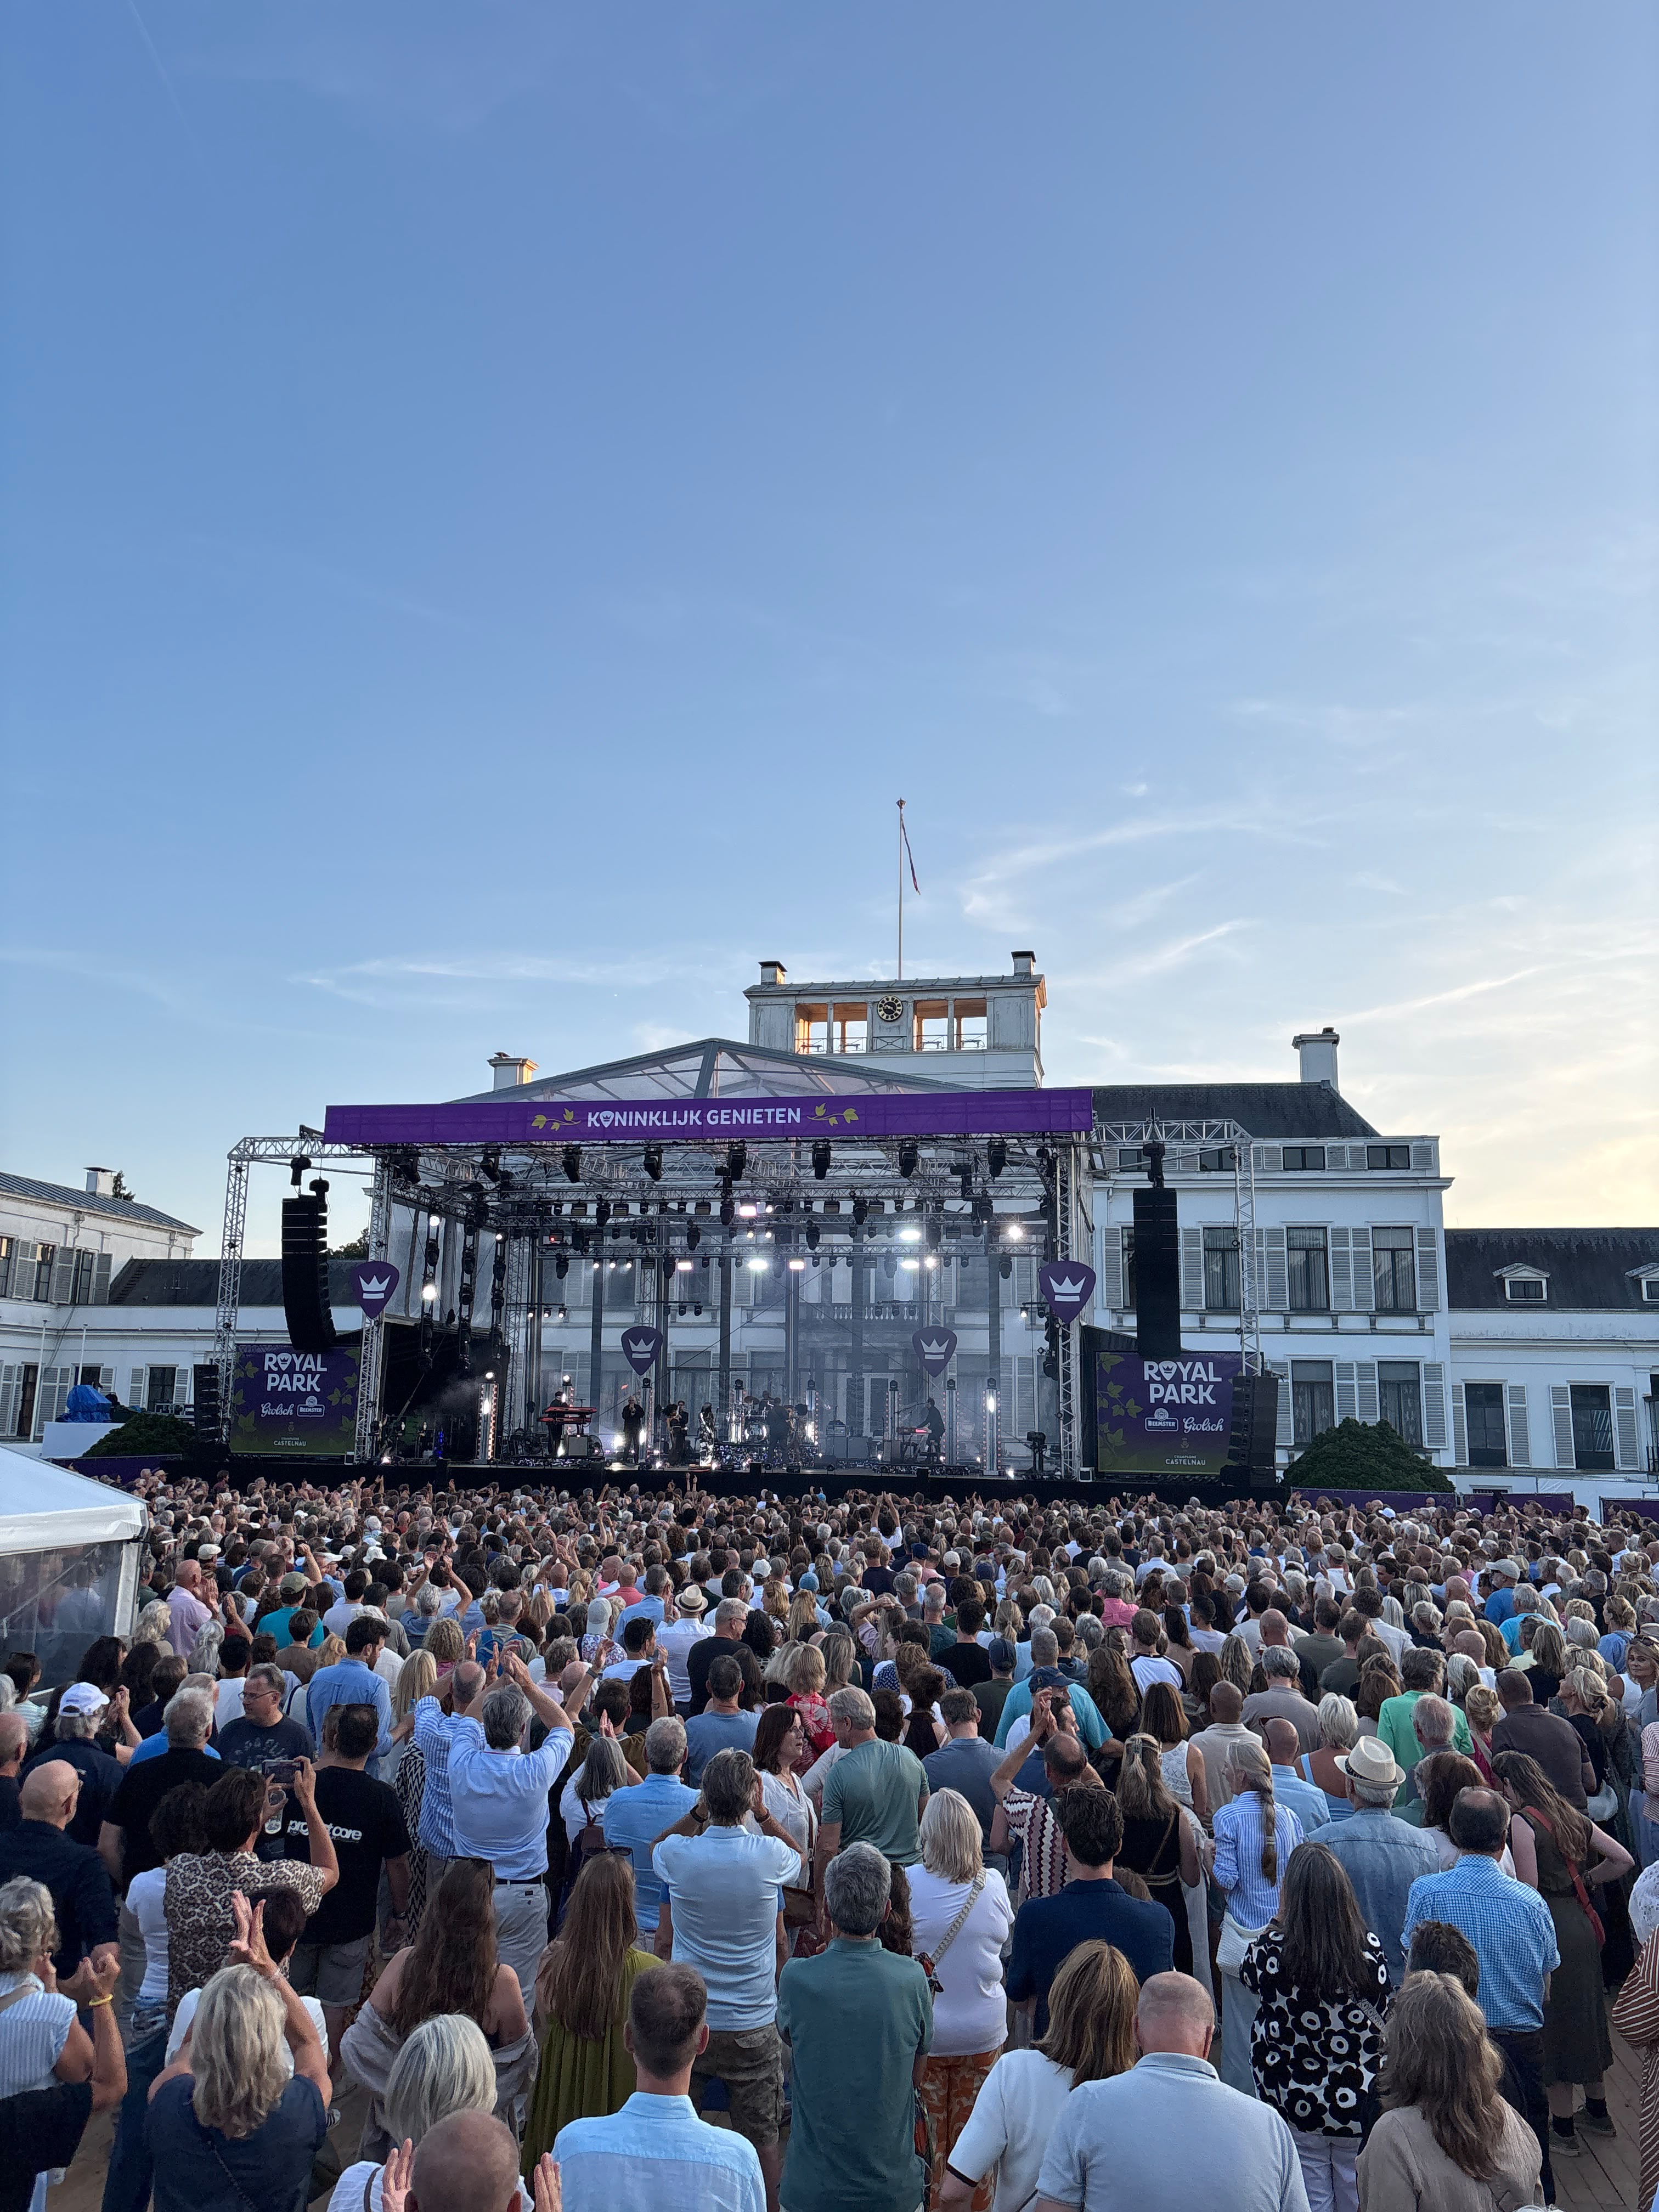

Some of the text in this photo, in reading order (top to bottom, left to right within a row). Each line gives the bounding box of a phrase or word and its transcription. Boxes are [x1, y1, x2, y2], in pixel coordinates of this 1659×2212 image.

[587, 1108, 800, 1128] KONINKLIJK GENIETEN
[264, 1352, 328, 1372] ROYAL
[1144, 1361, 1222, 1382] ROYAL
[267, 1373, 321, 1392] PARK
[1149, 1383, 1216, 1404] PARK
[261, 1402, 295, 1417] Grolsch
[1182, 1417, 1224, 1434] Grolsch
